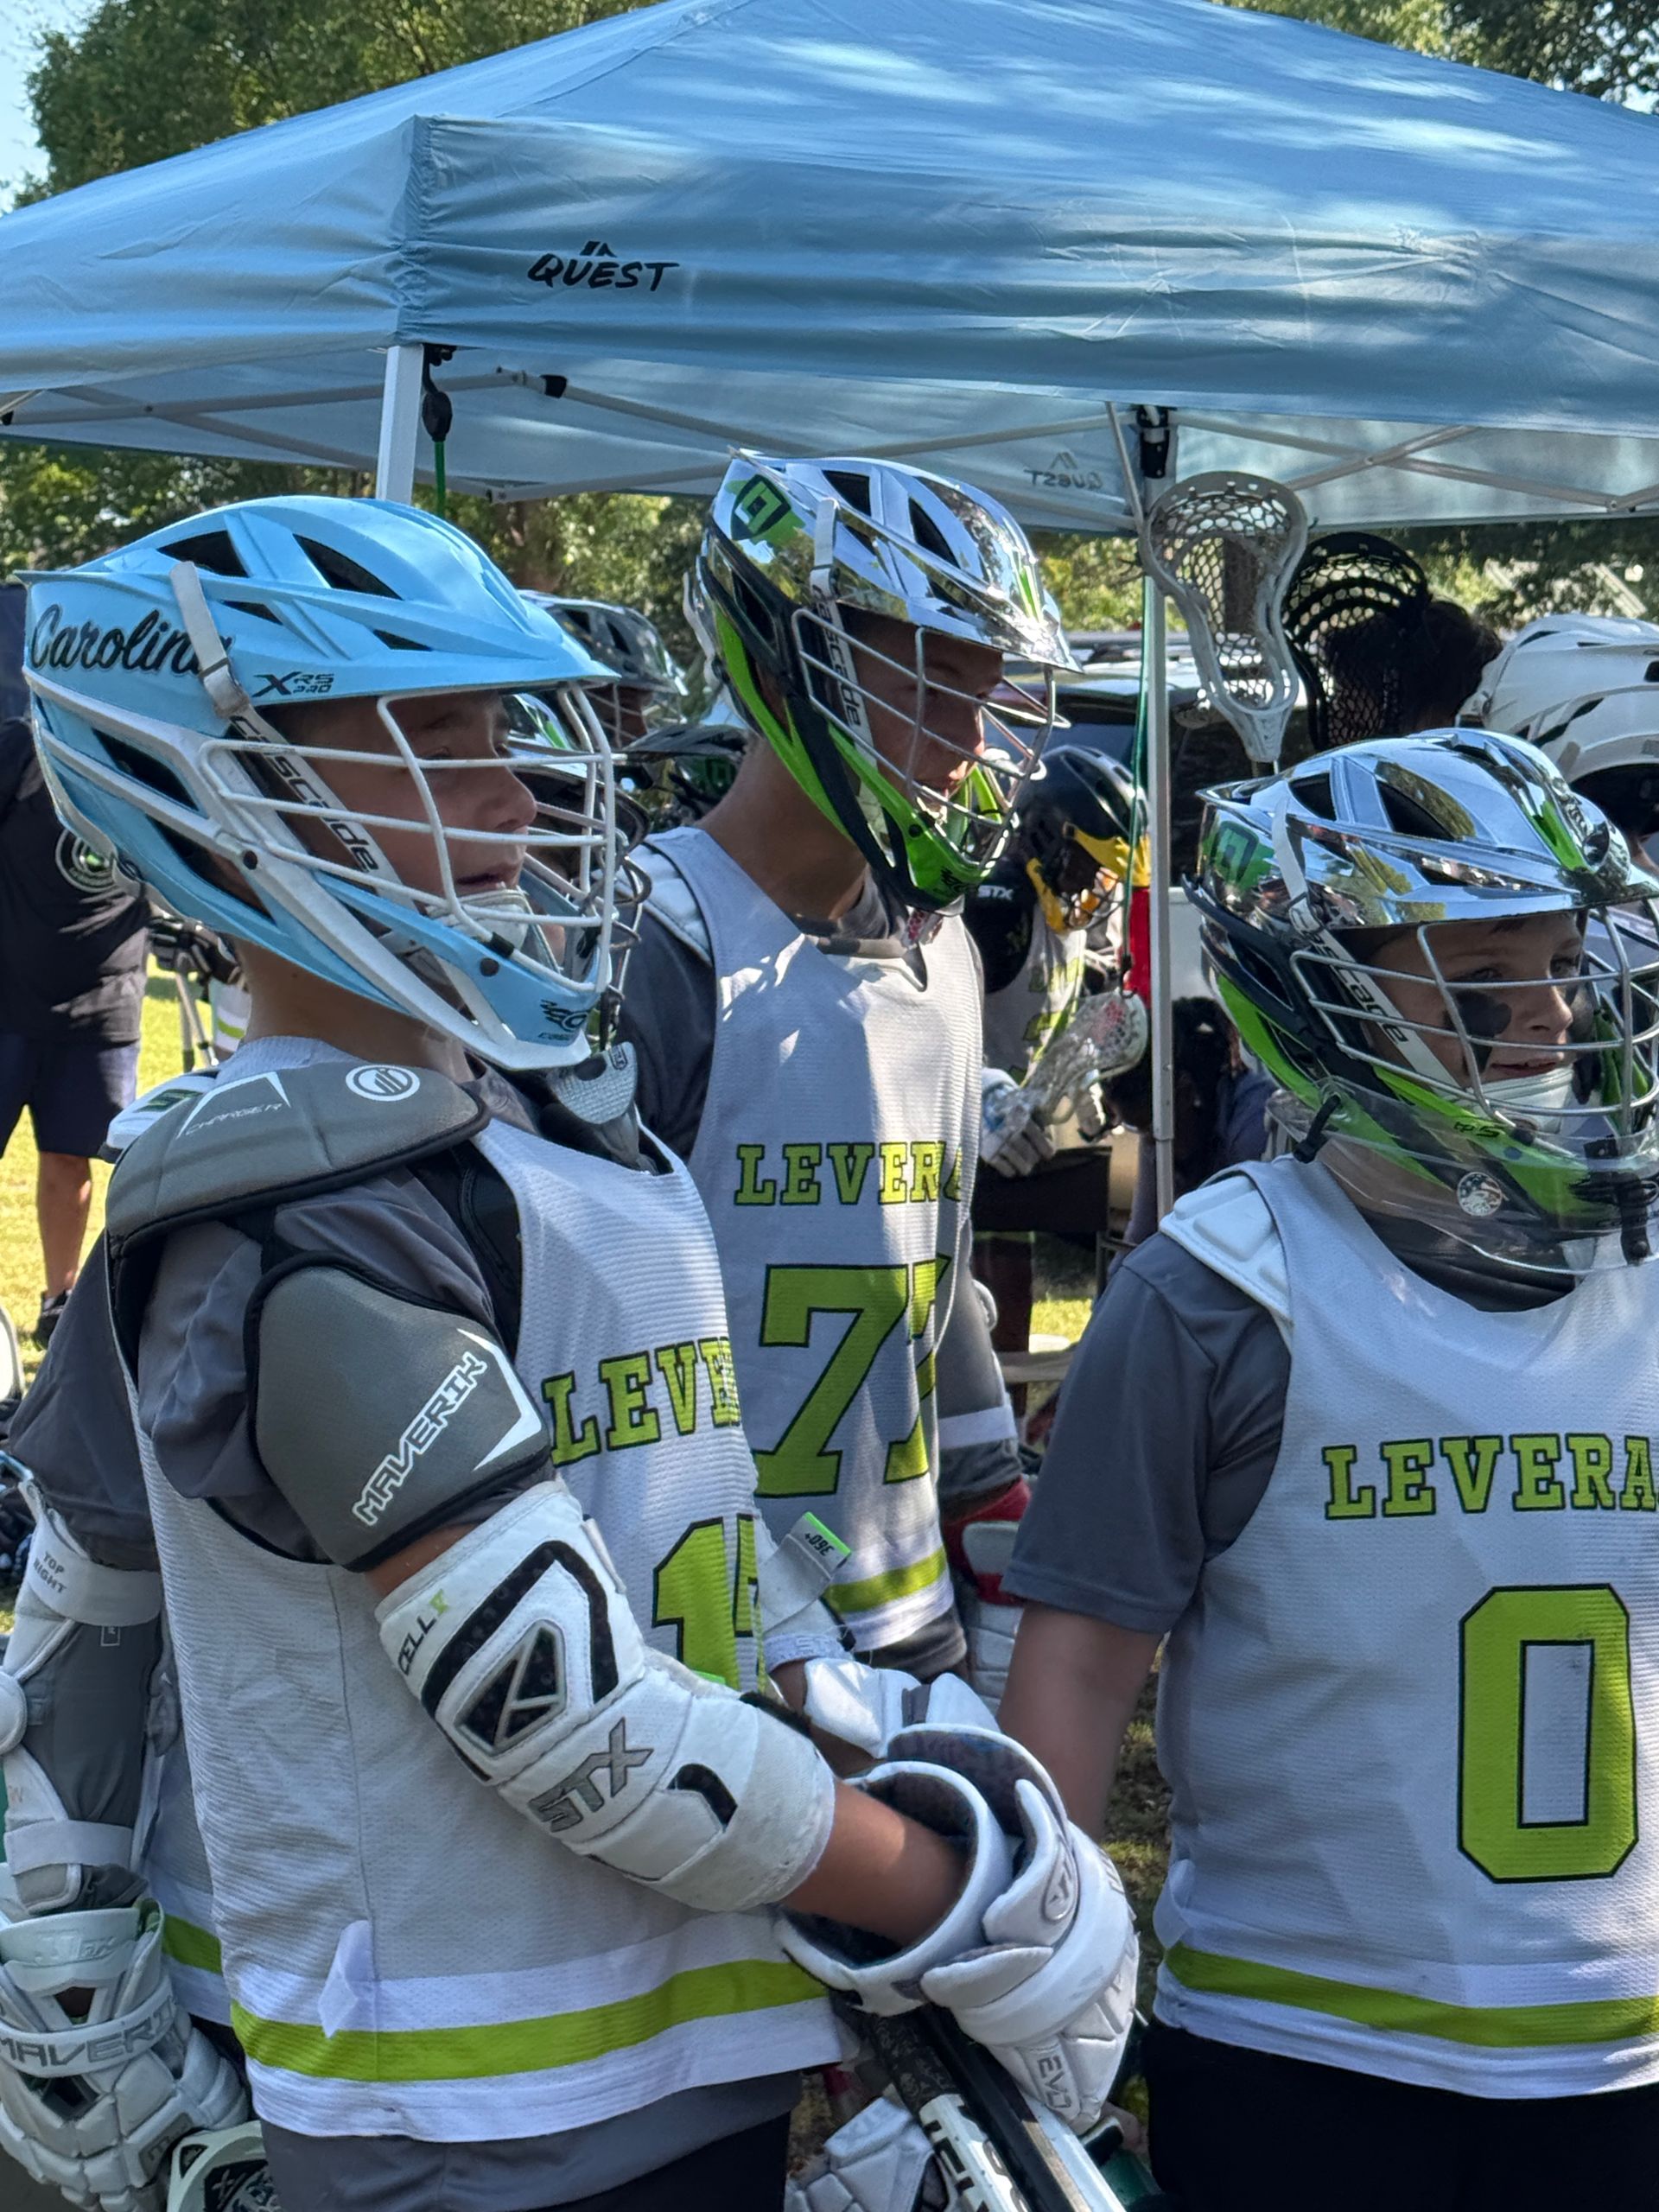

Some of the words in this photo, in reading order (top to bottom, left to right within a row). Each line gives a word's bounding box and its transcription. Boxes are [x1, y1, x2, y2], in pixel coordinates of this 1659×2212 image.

[527, 253, 680, 292] QUEST
[230, 715, 379, 874] cscde
[977, 885, 1014, 900] STX
[352, 1351, 487, 1526] MAVERIK
[1322, 1433, 1659, 1521] LEVERA
[33, 1558, 67, 1593] RIGHT
[44, 1552, 65, 1574] TOP
[1459, 1583, 1640, 1885] 0
[527, 1713, 655, 1834] STX
[0, 1996, 175, 2068] MAVERI
[1038, 2056, 1071, 2108] EVO
